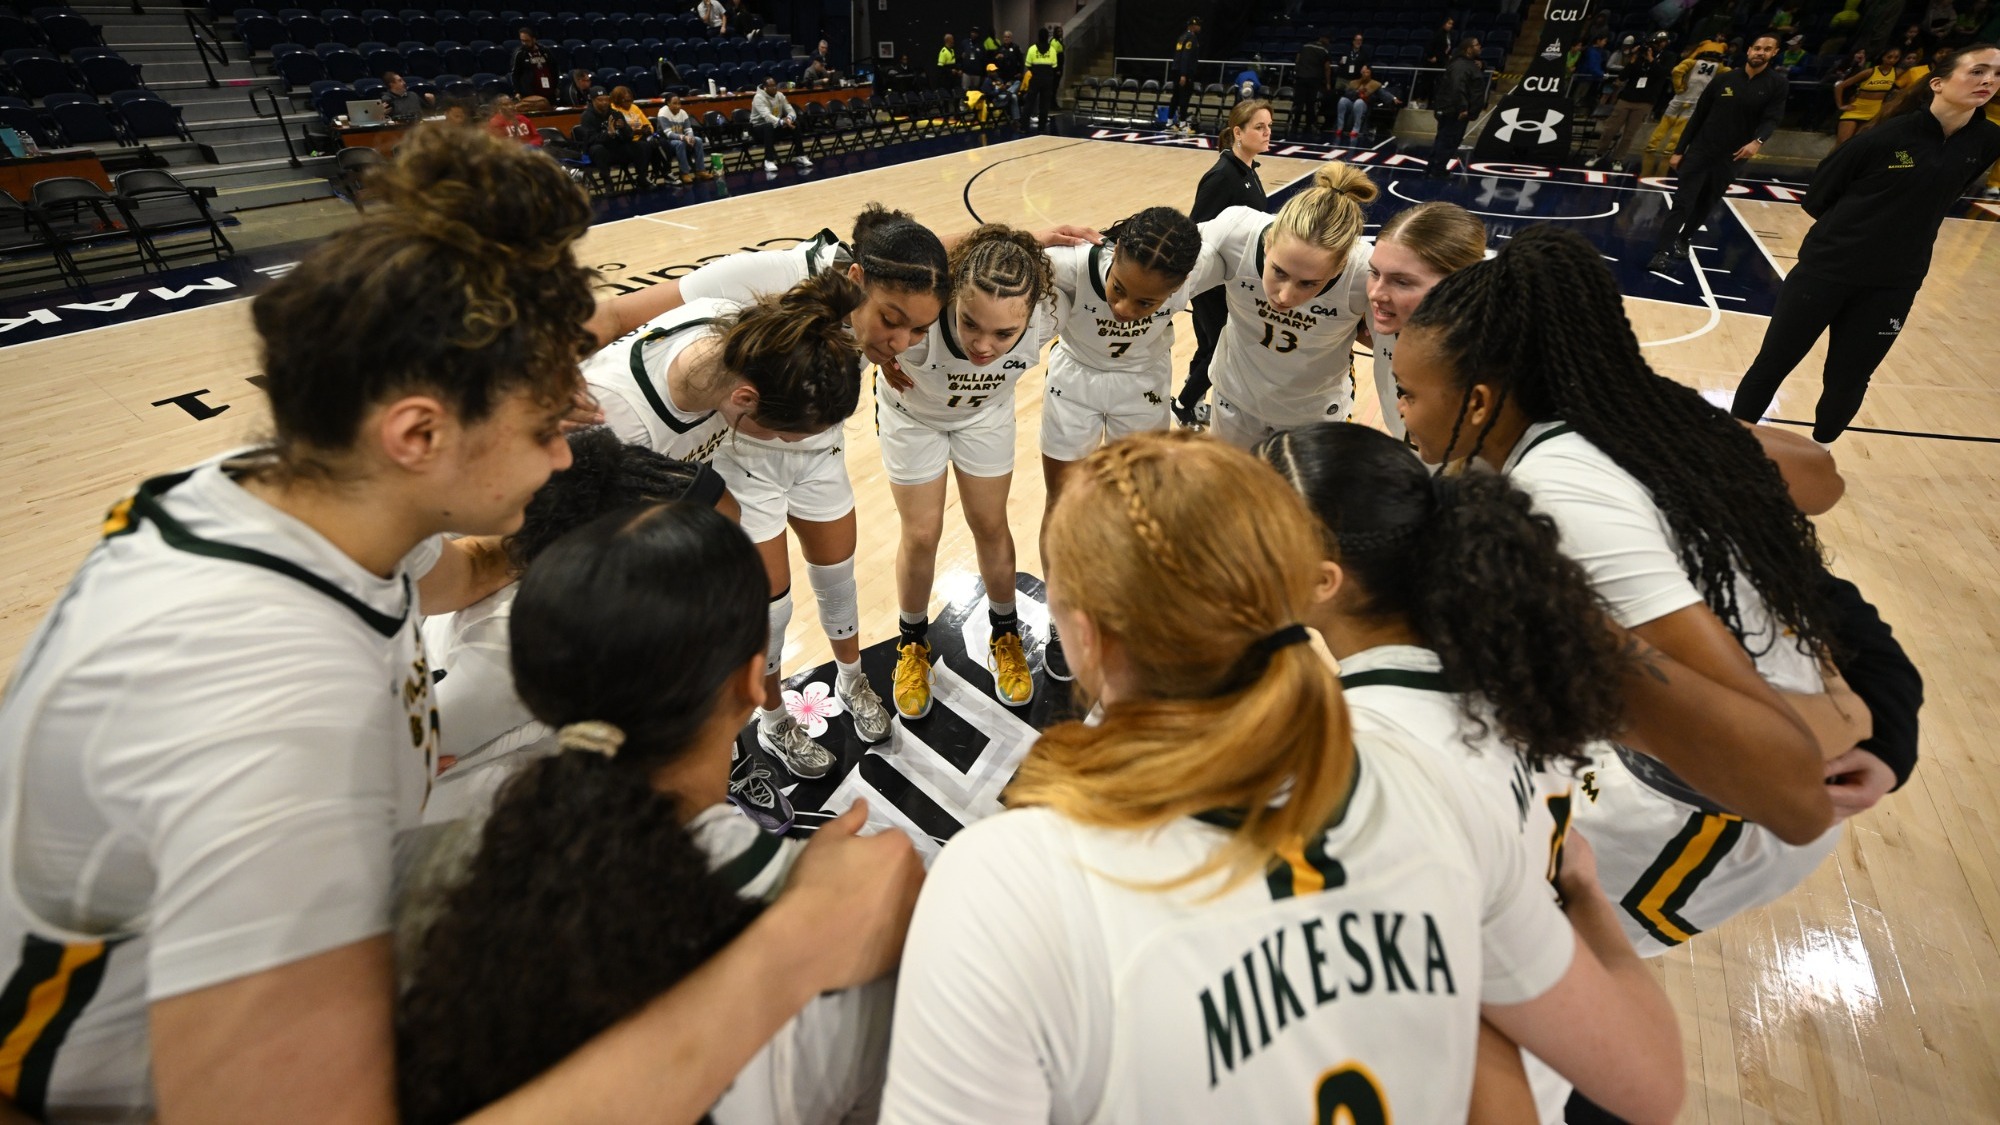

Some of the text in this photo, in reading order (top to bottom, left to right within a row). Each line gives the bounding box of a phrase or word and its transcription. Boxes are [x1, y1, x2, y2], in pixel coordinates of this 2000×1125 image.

[1550, 9, 1577, 22] CU1
[1697, 62, 1713, 76] 34
[1522, 76, 1560, 93] CU1
[1254, 298, 1317, 325] WIIAM
[1310, 304, 1338, 317] CAA
[1096, 317, 1153, 330] WILLIAM
[1259, 321, 1298, 353] 13
[1108, 342, 1133, 358] 7
[1002, 360, 1027, 370] CAA
[947, 373, 1006, 383] WILLIAM
[947, 395, 989, 408] 15
[1198, 910, 1458, 1091] MIKESKA
